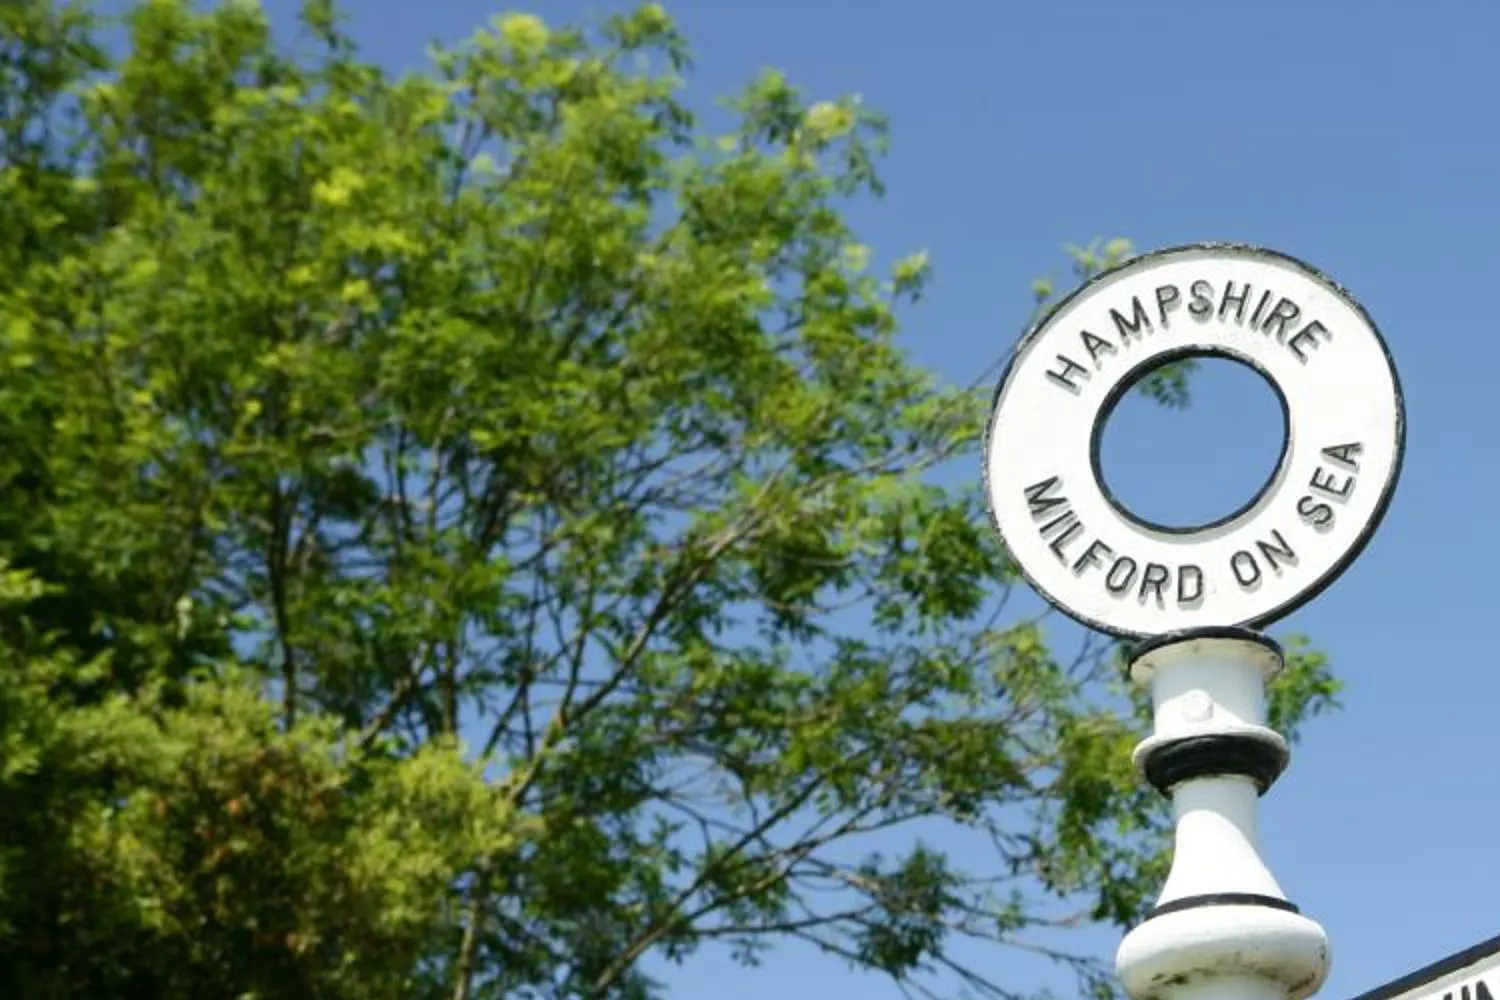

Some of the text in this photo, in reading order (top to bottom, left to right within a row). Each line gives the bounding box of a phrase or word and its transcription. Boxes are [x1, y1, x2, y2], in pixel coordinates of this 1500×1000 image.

[1045, 280, 1330, 394] HAMPSHIRE
[1024, 441, 1362, 605] MILFORD ON SEA
